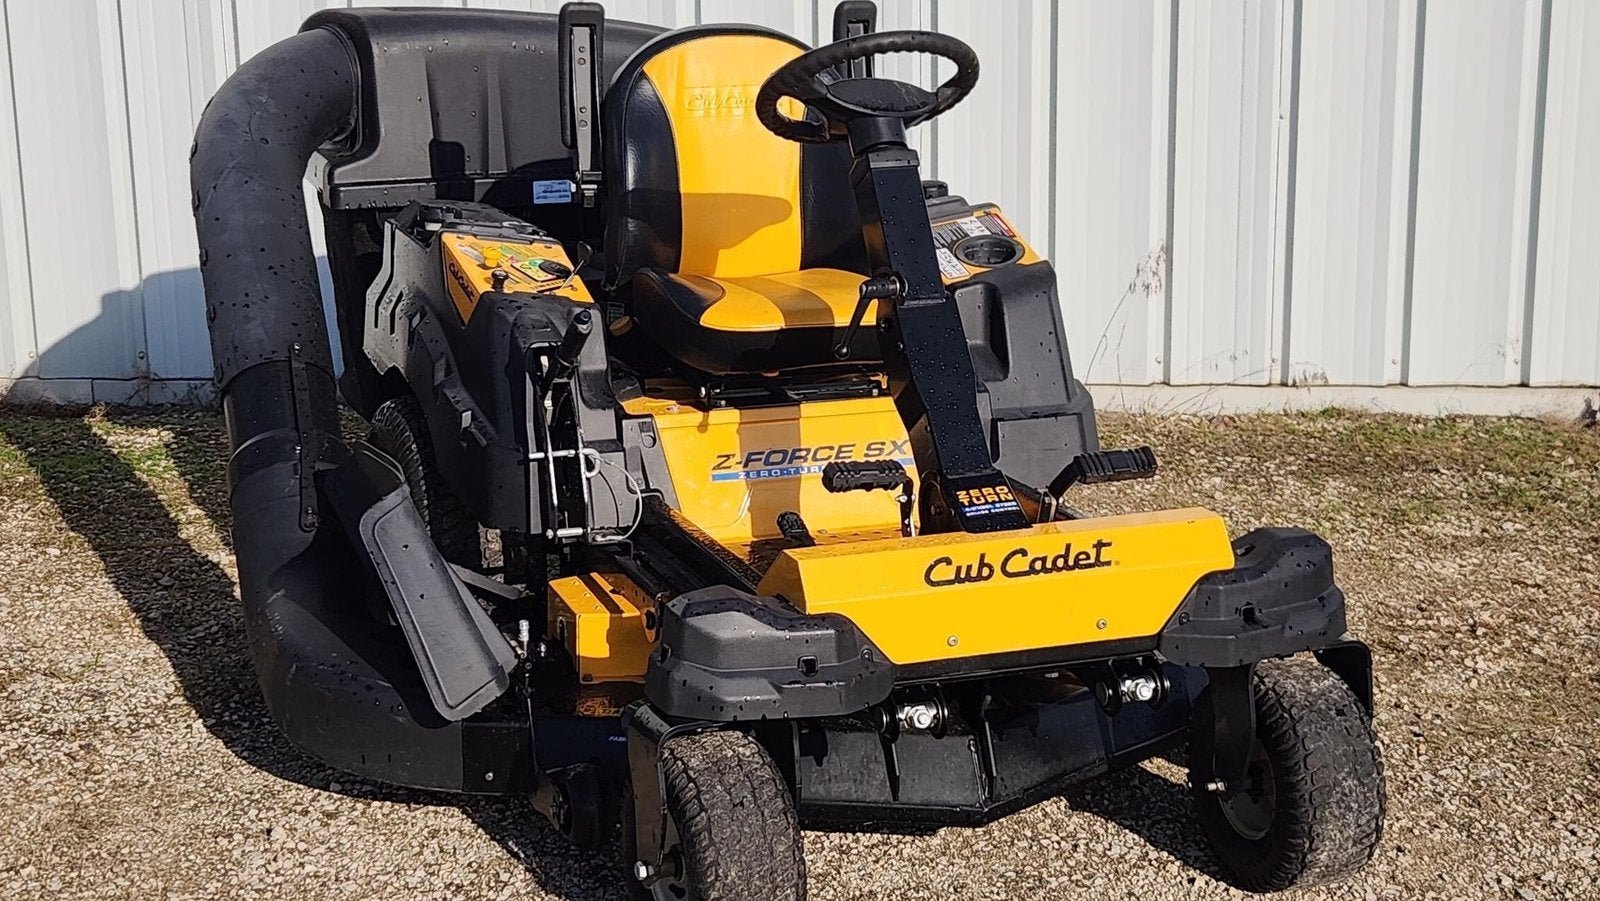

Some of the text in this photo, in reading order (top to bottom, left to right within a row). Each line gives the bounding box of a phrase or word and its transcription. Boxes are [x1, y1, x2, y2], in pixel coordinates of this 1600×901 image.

[712, 439, 909, 471] Z-FORCE SX
[956, 485, 1009, 499] ZERO
[959, 493, 1014, 506] TURN
[924, 538, 1112, 588] Cub Cadet
